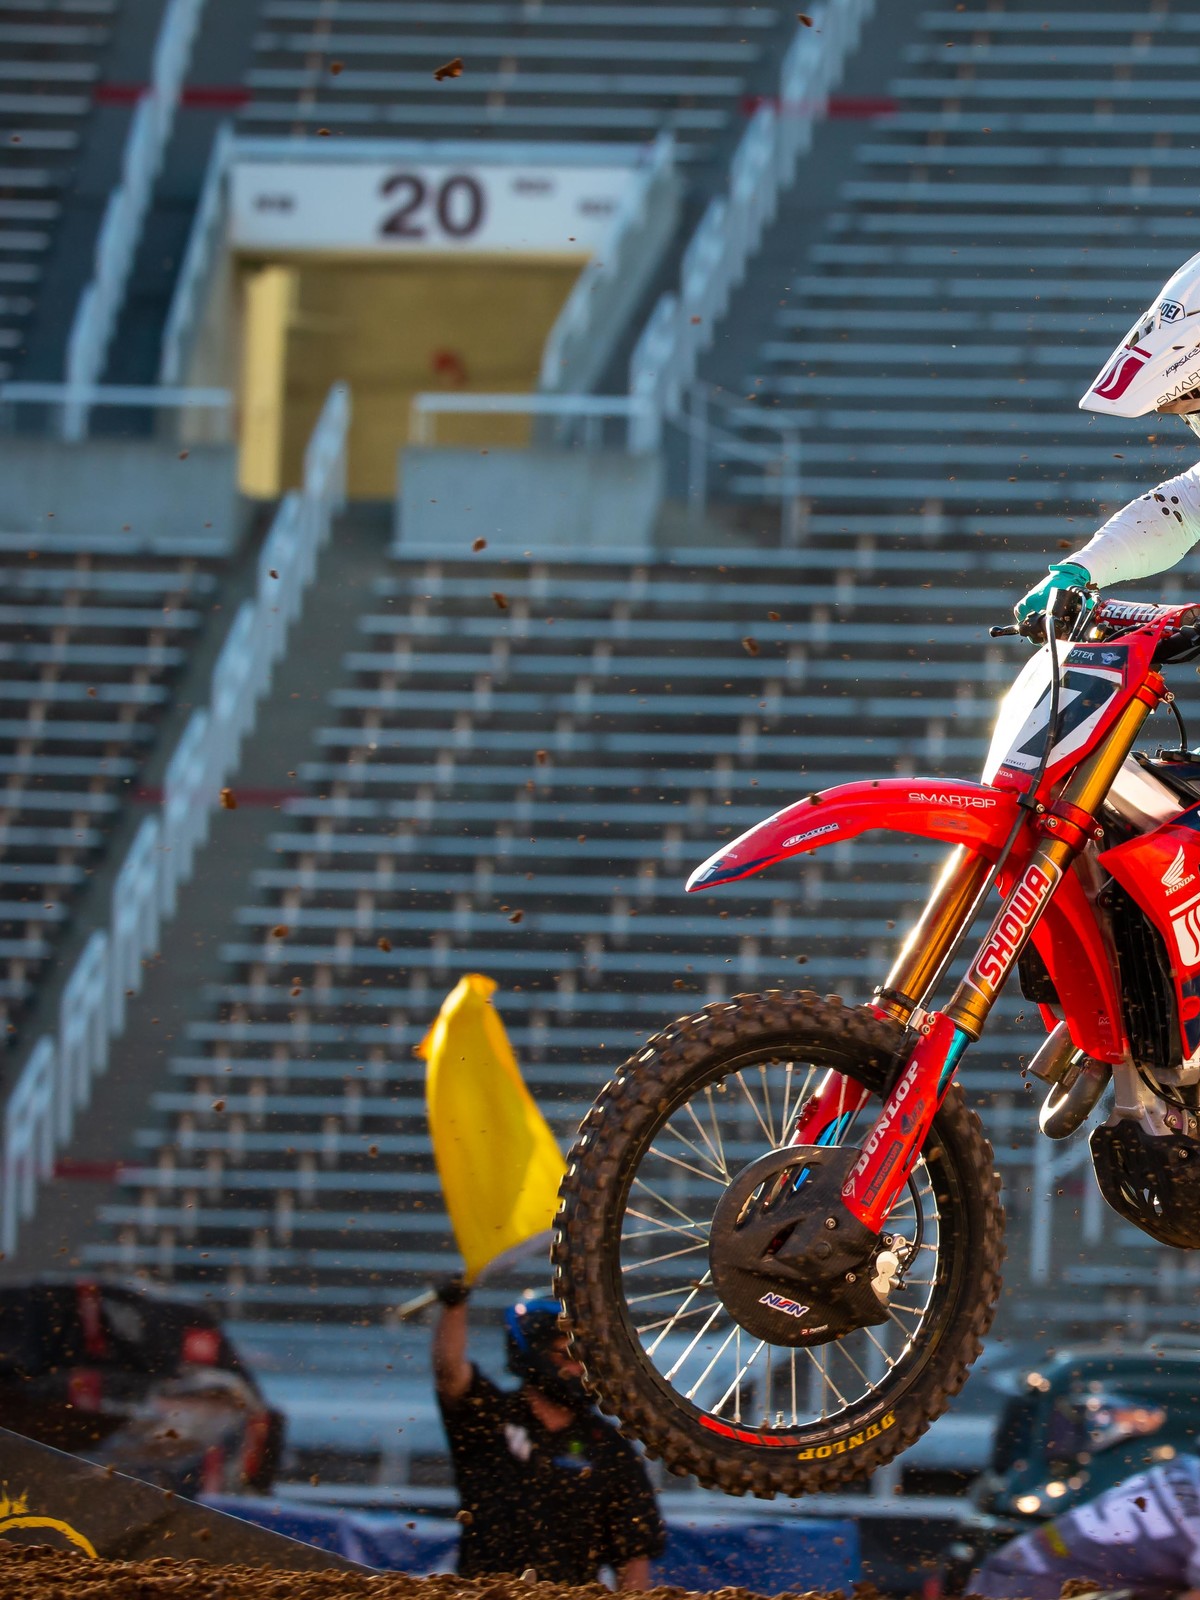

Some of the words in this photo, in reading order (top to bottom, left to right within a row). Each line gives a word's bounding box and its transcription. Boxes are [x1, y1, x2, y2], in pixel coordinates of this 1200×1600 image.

[379, 174, 487, 241] 20
[1160, 303, 1181, 320] OEI
[908, 792, 996, 808] SMARTOP
[1165, 874, 1196, 896] HONDA
[975, 864, 1052, 991] SHOWA
[854, 1060, 918, 1176] DUNLOP
[798, 1409, 896, 1460] DUNLOP
